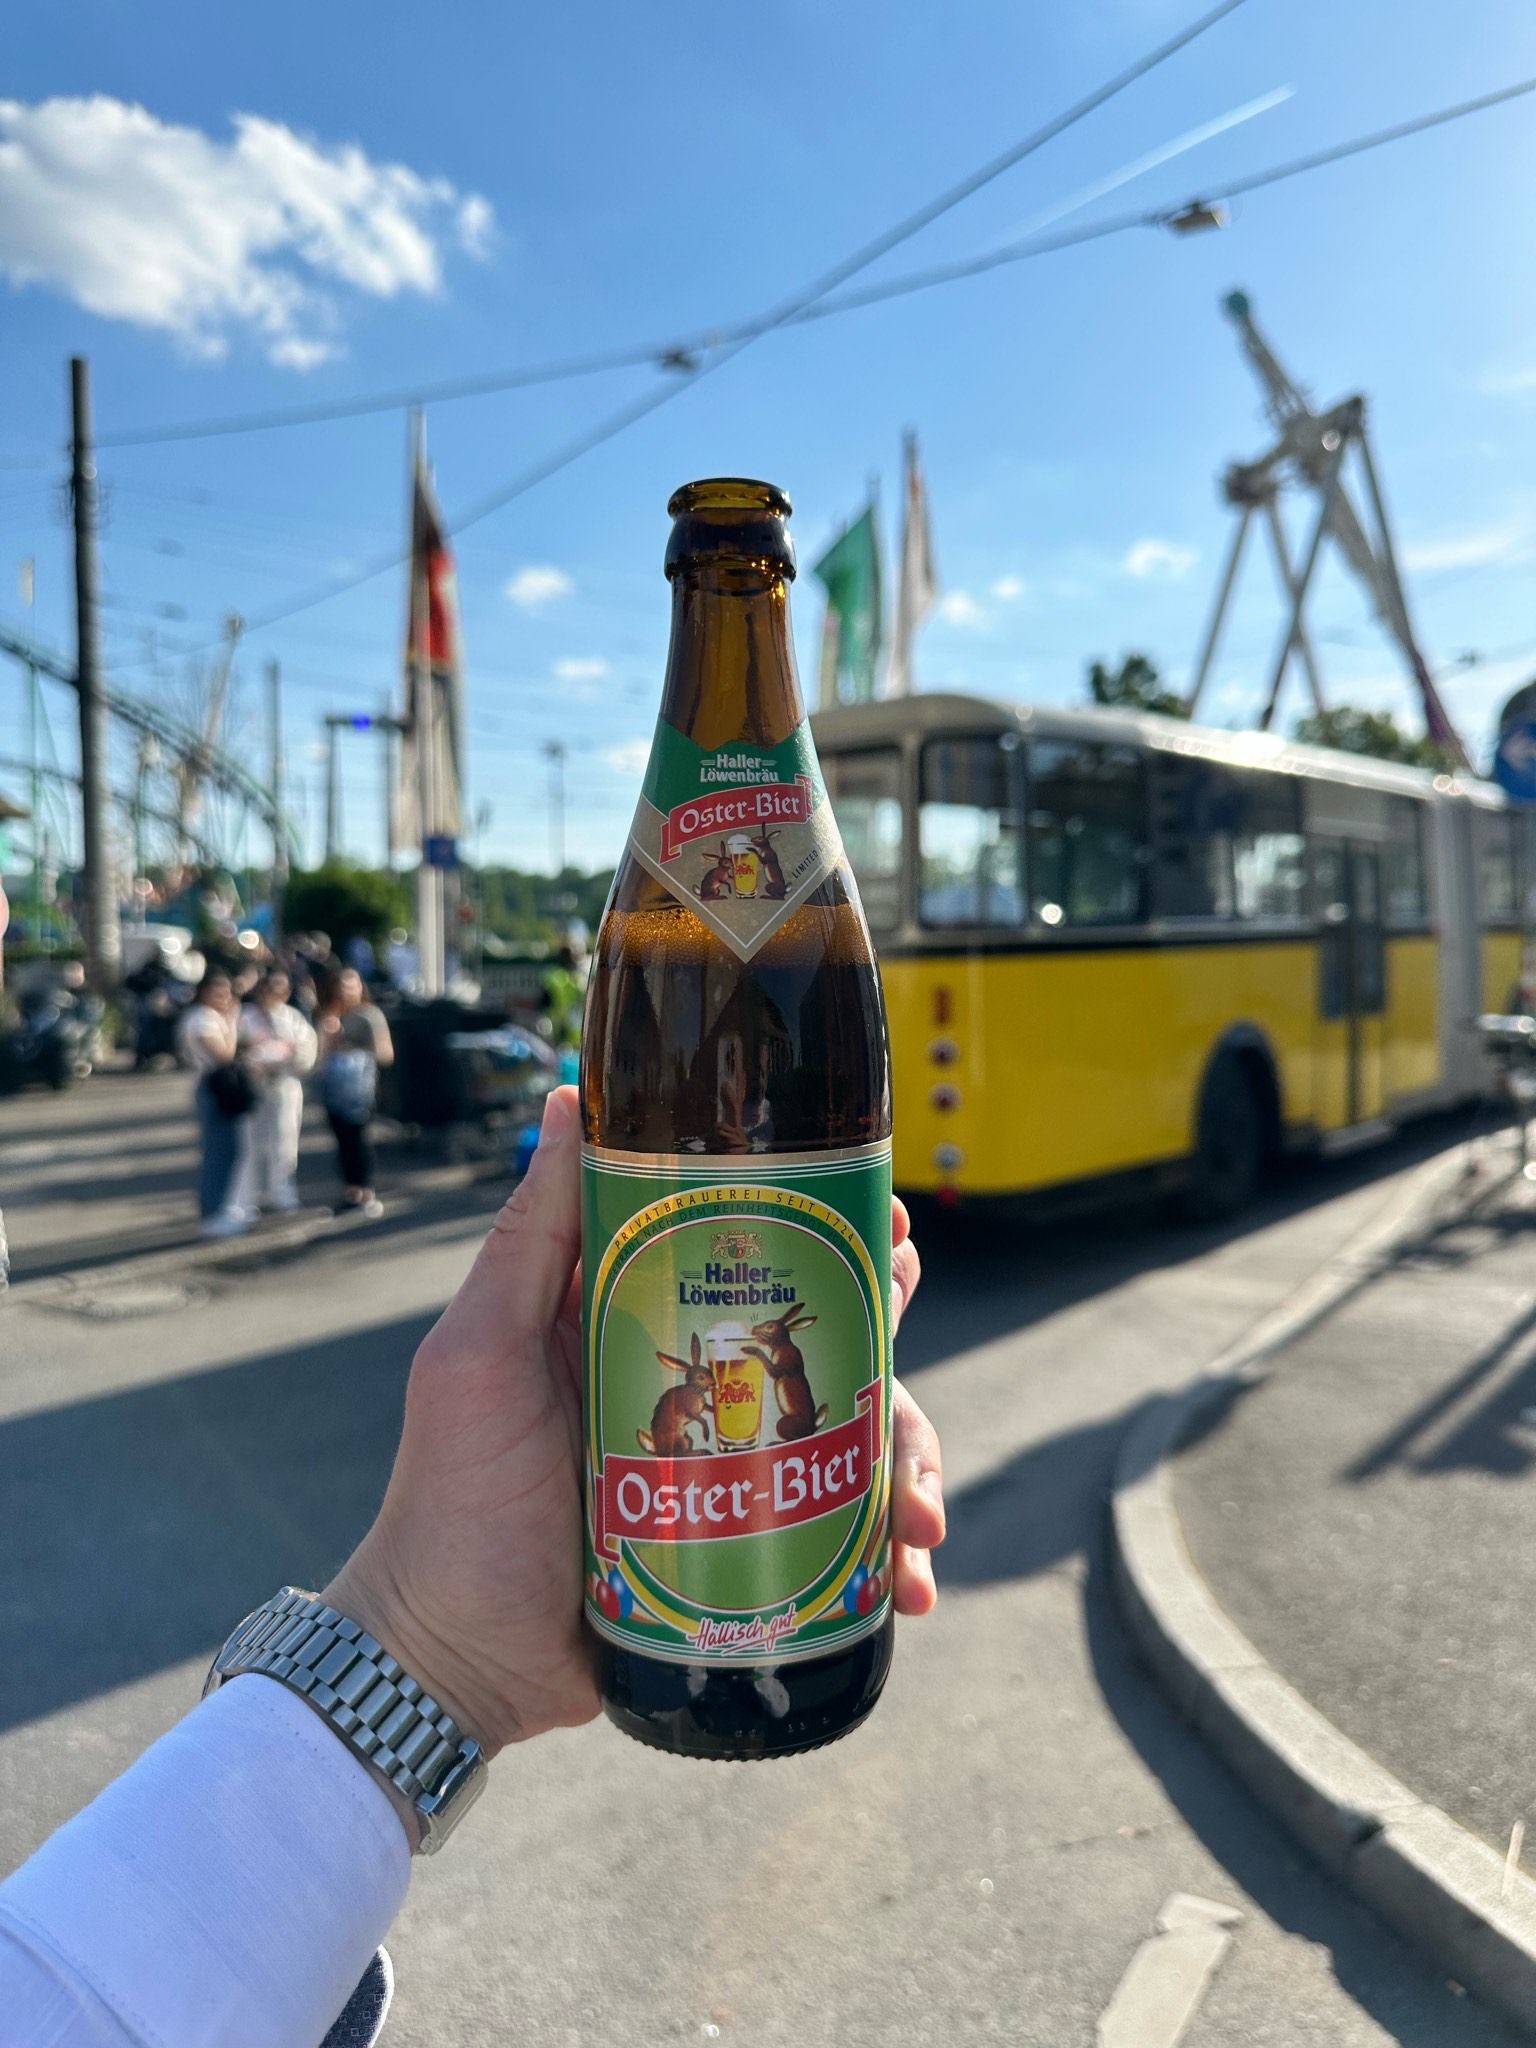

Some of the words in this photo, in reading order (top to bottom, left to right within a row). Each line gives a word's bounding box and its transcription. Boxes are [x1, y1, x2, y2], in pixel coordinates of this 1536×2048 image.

[700, 768, 779, 783] Löwenbräu
[716, 754, 762, 769] Haller
[679, 791, 800, 834] Oster-Bier
[791, 850, 819, 879] LIMITED
[614, 1189, 761, 1250] PRIVATBRAUEREI
[776, 1193, 815, 1213] SEIT
[825, 1212, 855, 1242] 1724
[609, 1237, 640, 1281] GEBRAUT
[643, 1217, 674, 1238] NACH
[680, 1208, 707, 1220] DEM
[714, 1204, 824, 1230] REINHEITSGEBOT
[827, 1230, 845, 1250] VON
[704, 1262, 772, 1284] Haller
[679, 1282, 796, 1306] Löwenbräu
[617, 1444, 860, 1525] Oster-Bier
[687, 1616, 764, 1650] Hällisch
[766, 1603, 797, 1652] gut
